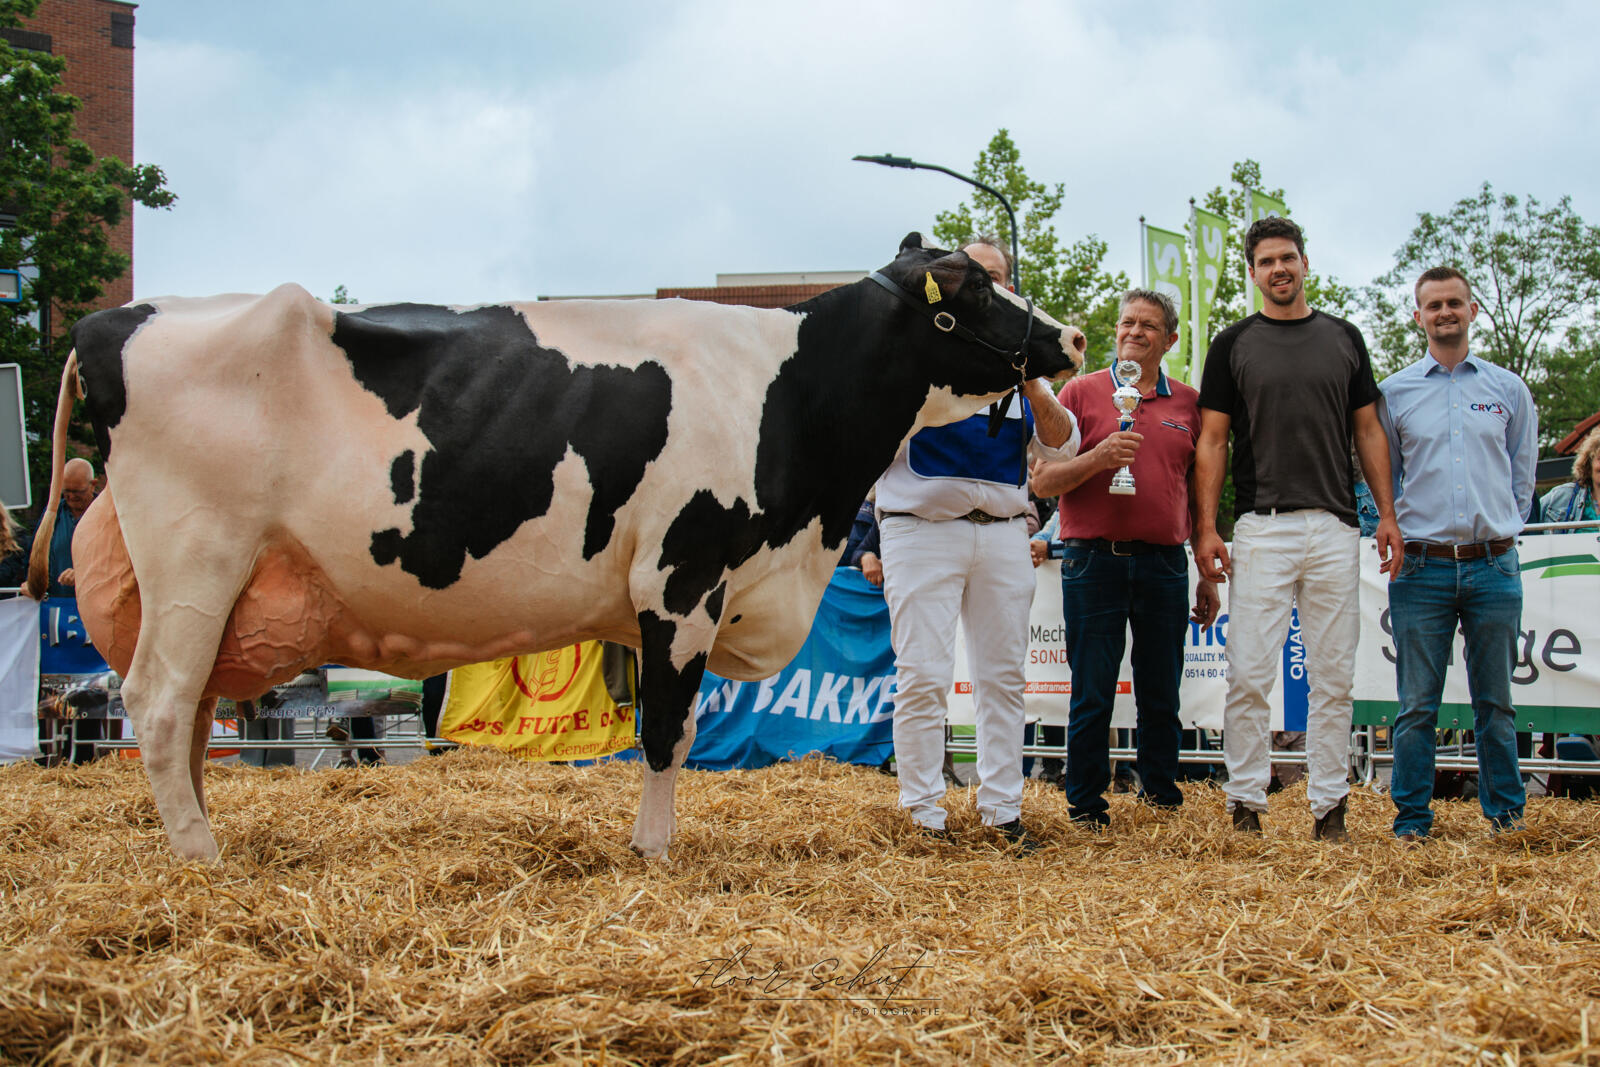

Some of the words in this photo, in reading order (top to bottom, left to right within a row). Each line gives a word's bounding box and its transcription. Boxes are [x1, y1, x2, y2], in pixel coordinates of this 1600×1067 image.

[1470, 403, 1493, 412] CRV
[1289, 615, 1304, 680] QMAC
[1184, 652, 1216, 662] QUALITY
[1184, 668, 1205, 679] 0514
[1207, 668, 1218, 679] 60
